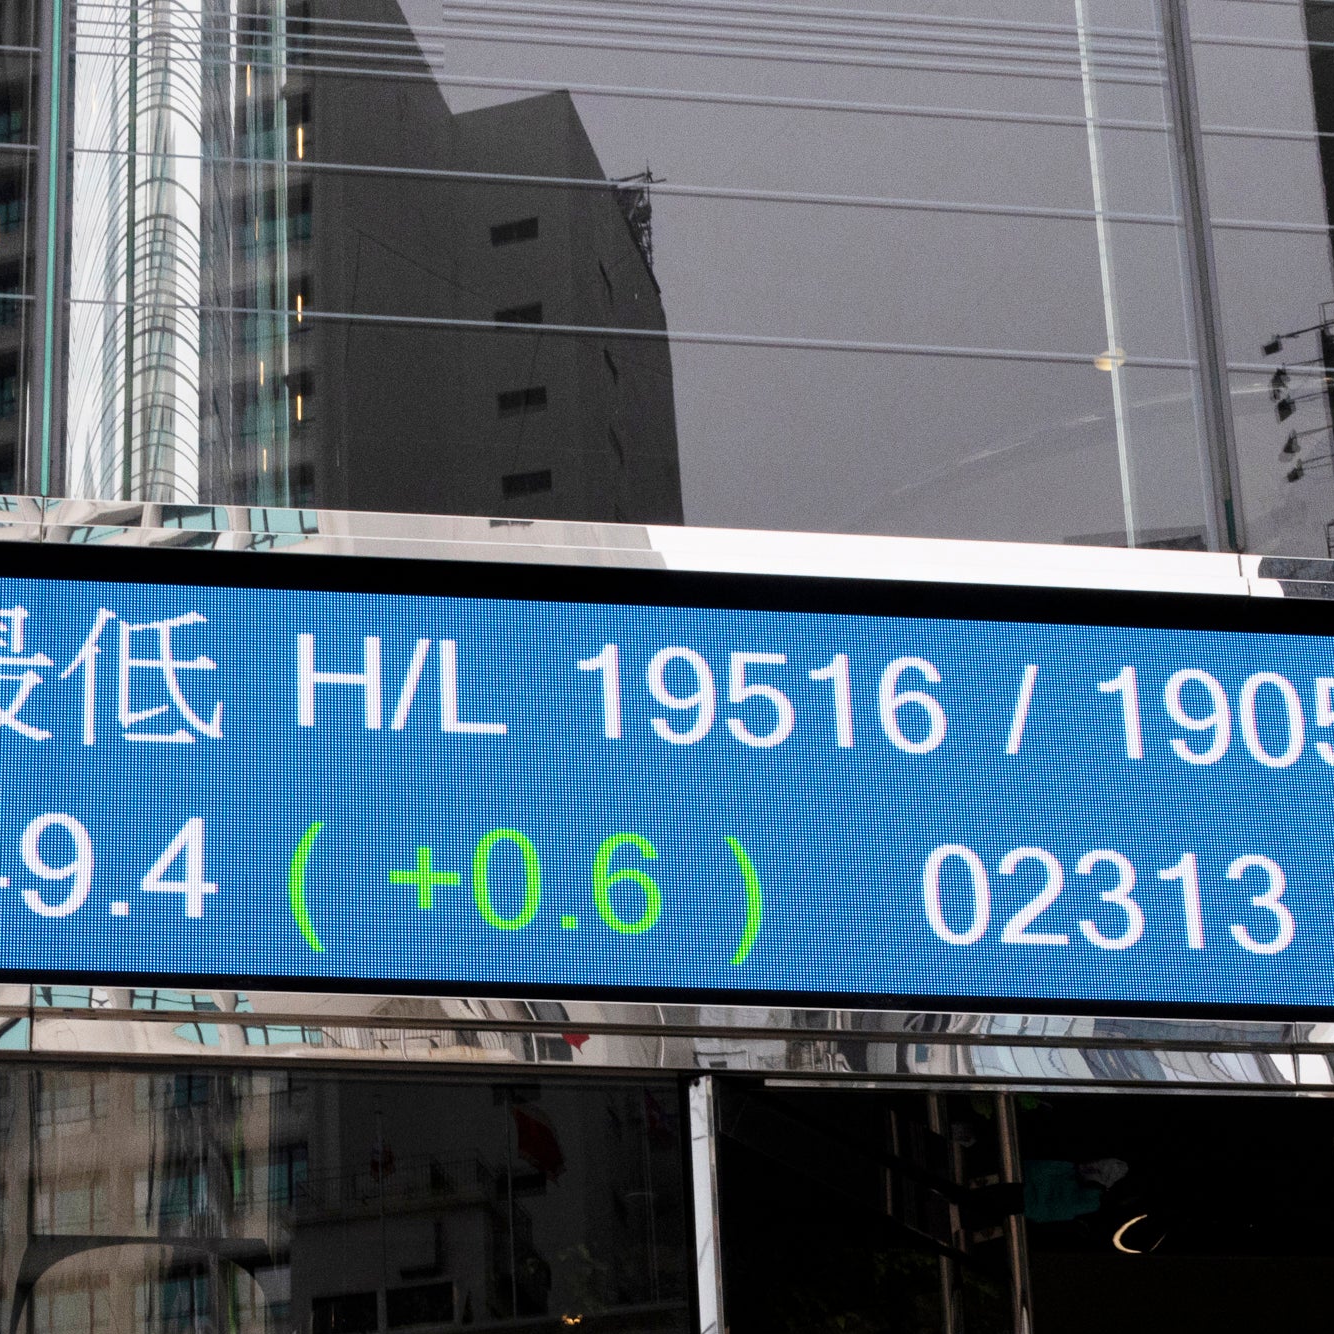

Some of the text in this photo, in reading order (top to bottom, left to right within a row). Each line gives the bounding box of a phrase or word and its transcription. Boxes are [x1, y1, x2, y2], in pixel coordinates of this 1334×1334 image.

[297, 630, 508, 737] H/L
[577, 643, 948, 756] 19516
[921, 842, 1297, 955] 02313
